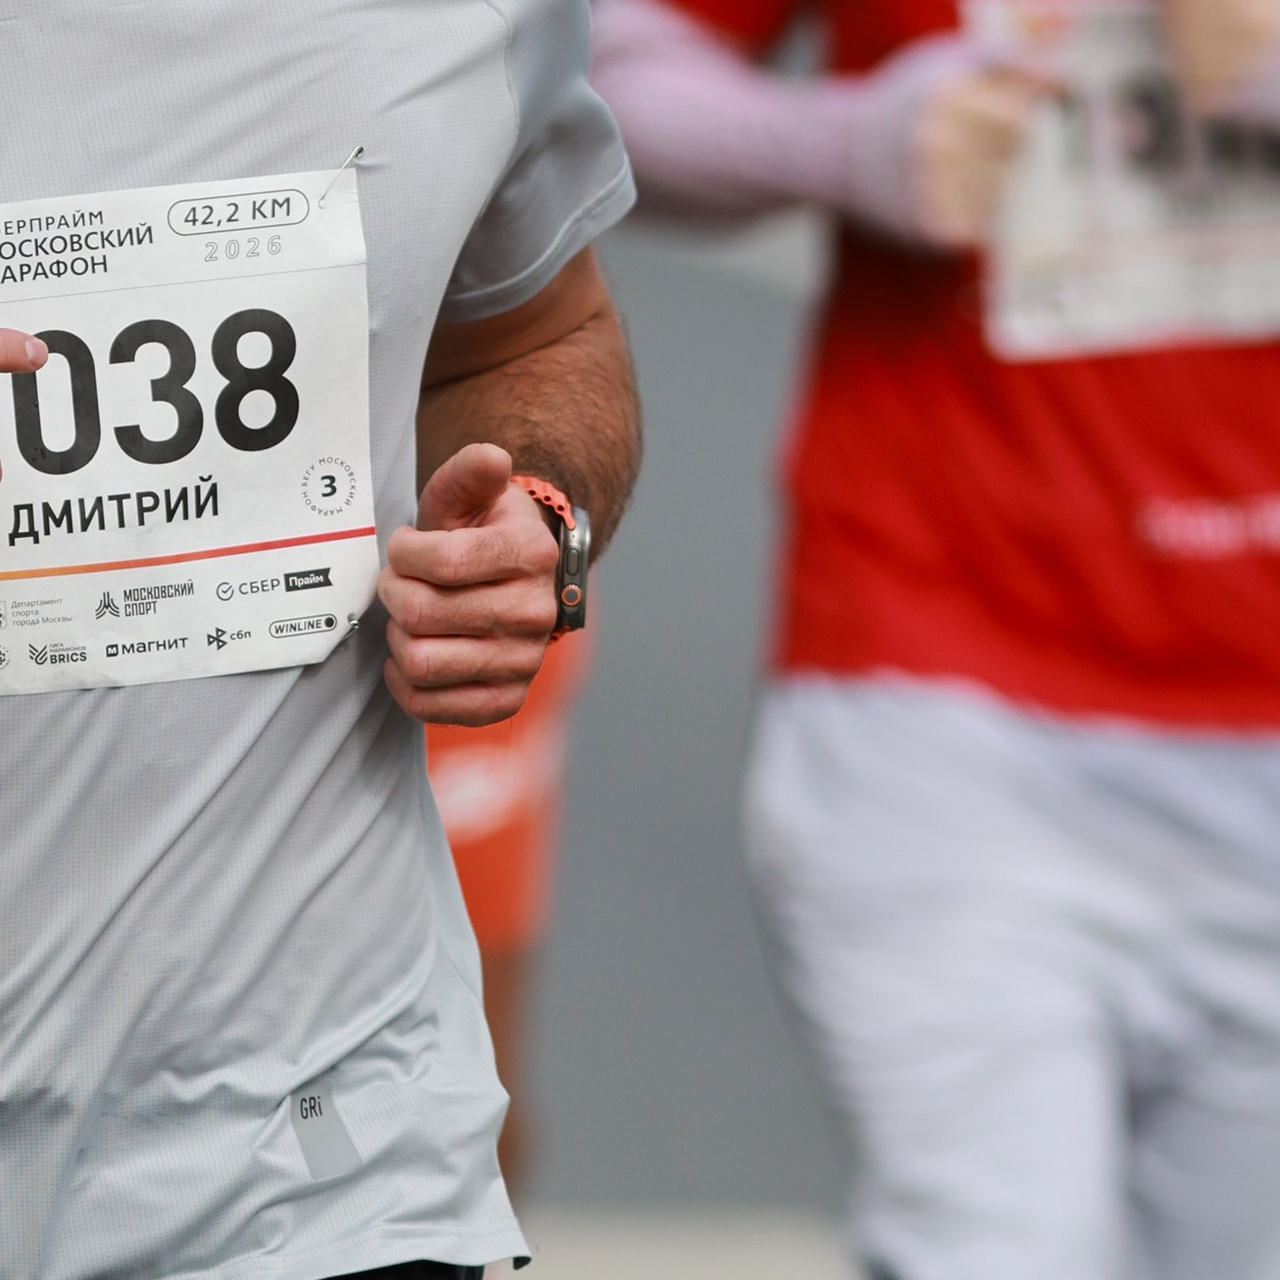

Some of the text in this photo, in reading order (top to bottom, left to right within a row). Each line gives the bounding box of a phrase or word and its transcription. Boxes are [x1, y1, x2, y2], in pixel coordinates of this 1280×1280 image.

[183, 197, 291, 227] 42,2 КМ
[204, 234, 282, 262] 2026
[320, 474, 338, 498] 3
[8, 474, 219, 547] ДМИТРИЙ
[123, 579, 195, 602] МОСКОВСКИЙ
[238, 573, 324, 595] СБЕР Прайм
[11, 598, 63, 609] Департамент
[124, 600, 158, 617] СПОРТ
[11, 609, 39, 618] спорта
[12, 616, 73, 627] города Москвы
[274, 618, 323, 635] WINLINE
[229, 630, 252, 641] сбп
[121, 637, 189, 655] магнит
[50, 651, 87, 664] BRICS
